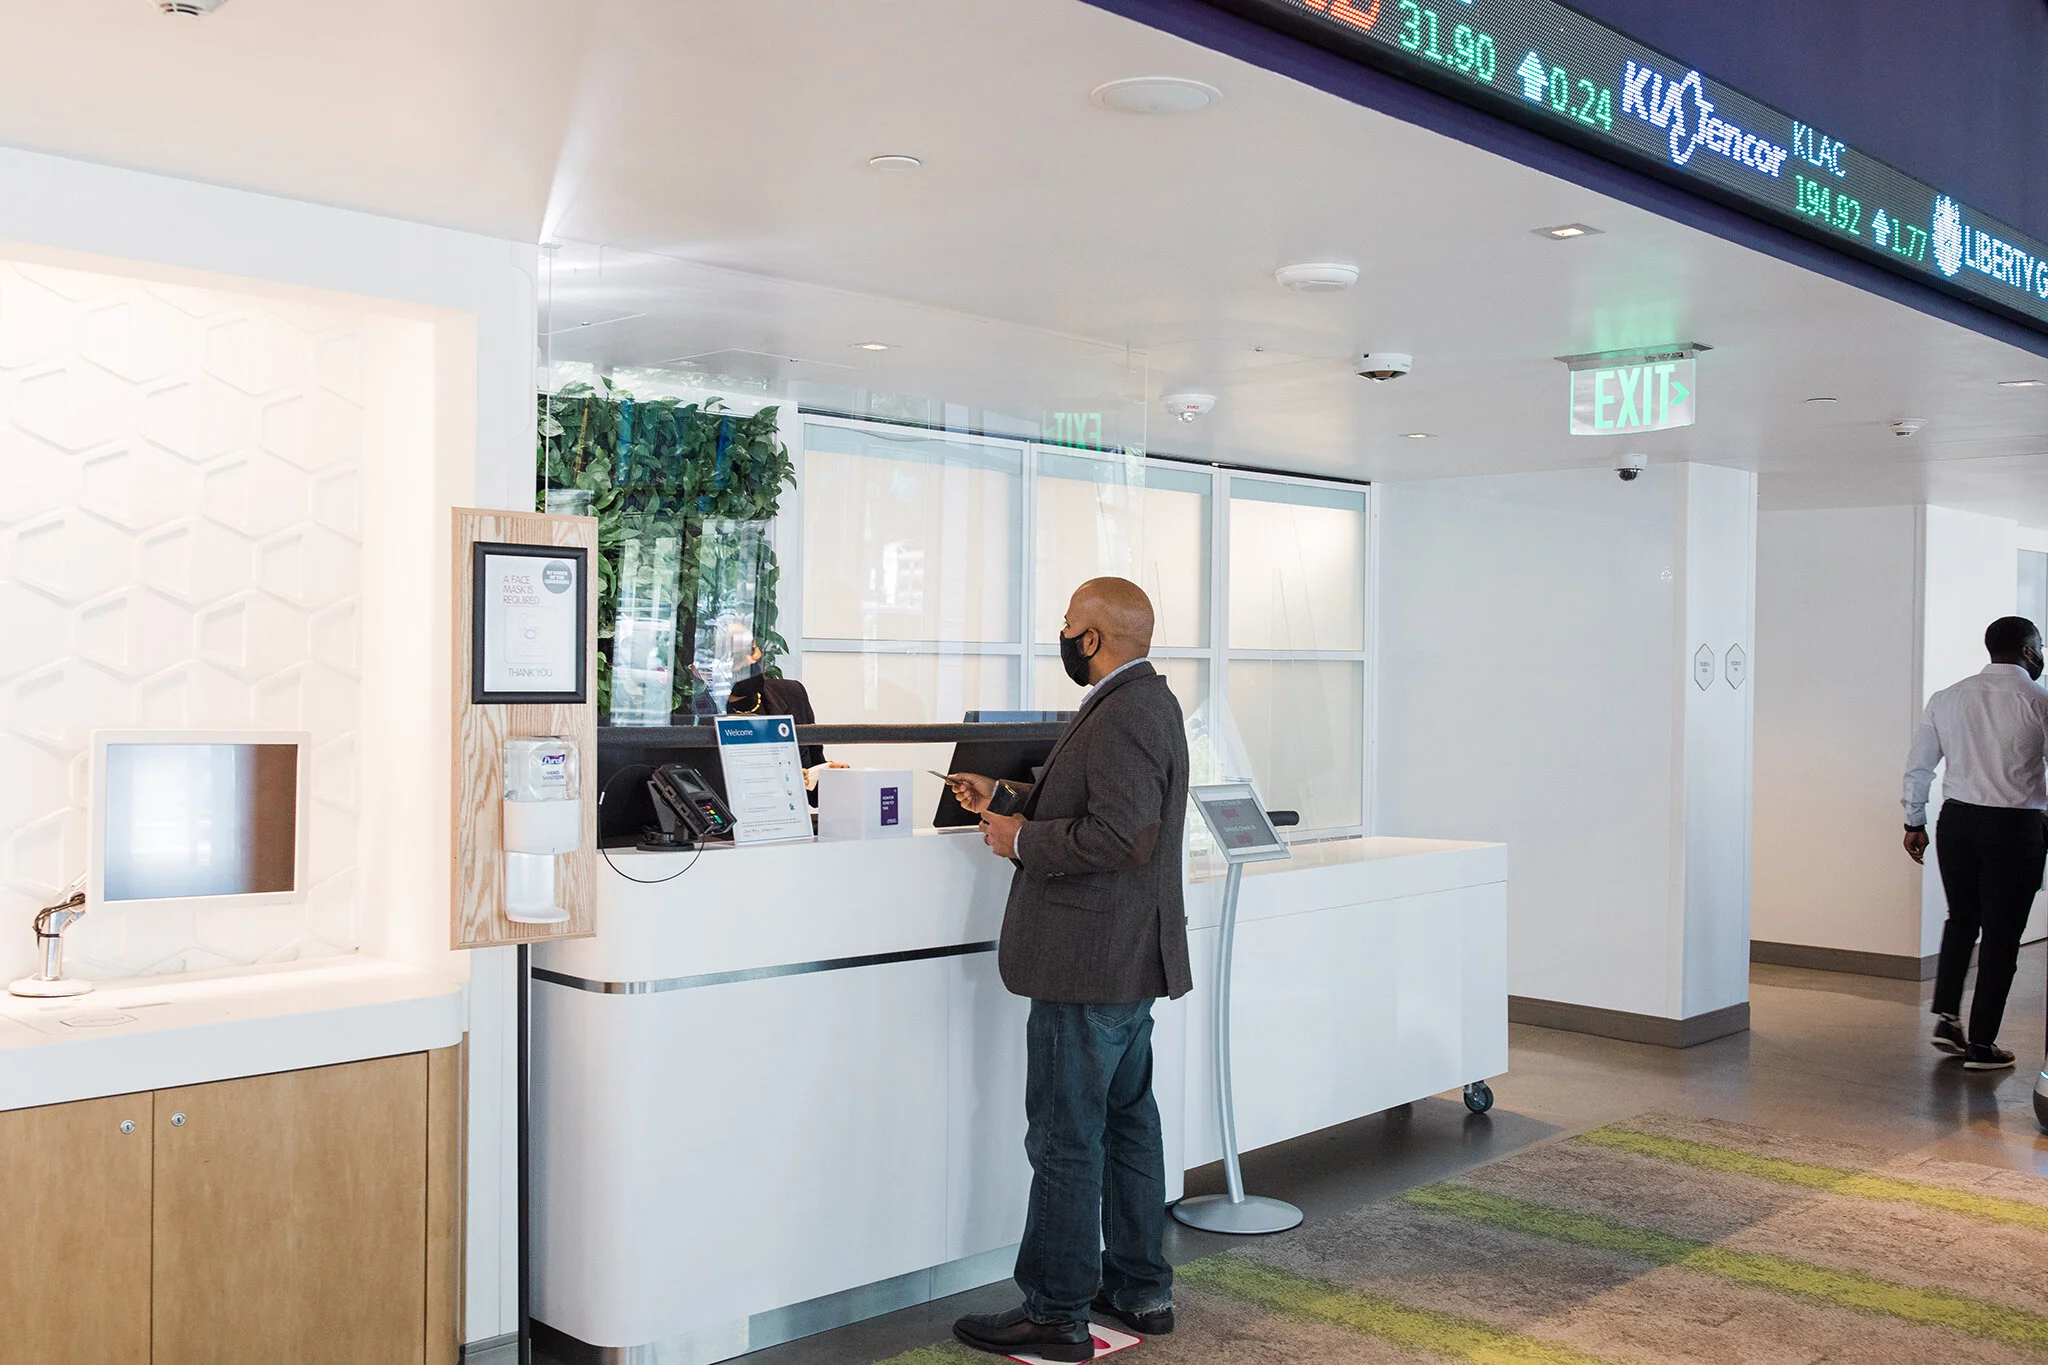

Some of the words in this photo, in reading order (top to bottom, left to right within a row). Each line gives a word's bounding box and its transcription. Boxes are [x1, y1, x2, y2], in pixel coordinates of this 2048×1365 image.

[1399, 0, 1496, 82] 31.90
[1550, 66, 1612, 131] 0.24
[1793, 120, 1846, 177] KLAC
[1795, 174, 1862, 236] 194.92
[1964, 225, 2035, 292] LIBERTY
[1594, 363, 1676, 430] EXIT
[503, 575, 510, 584] A
[511, 575, 531, 584] FACE
[503, 585, 526, 594] MASK
[503, 595, 540, 605] REQUIRED
[508, 668, 534, 677] THANK
[534, 667, 553, 677] YOU
[724, 728, 754, 737] Welcome
